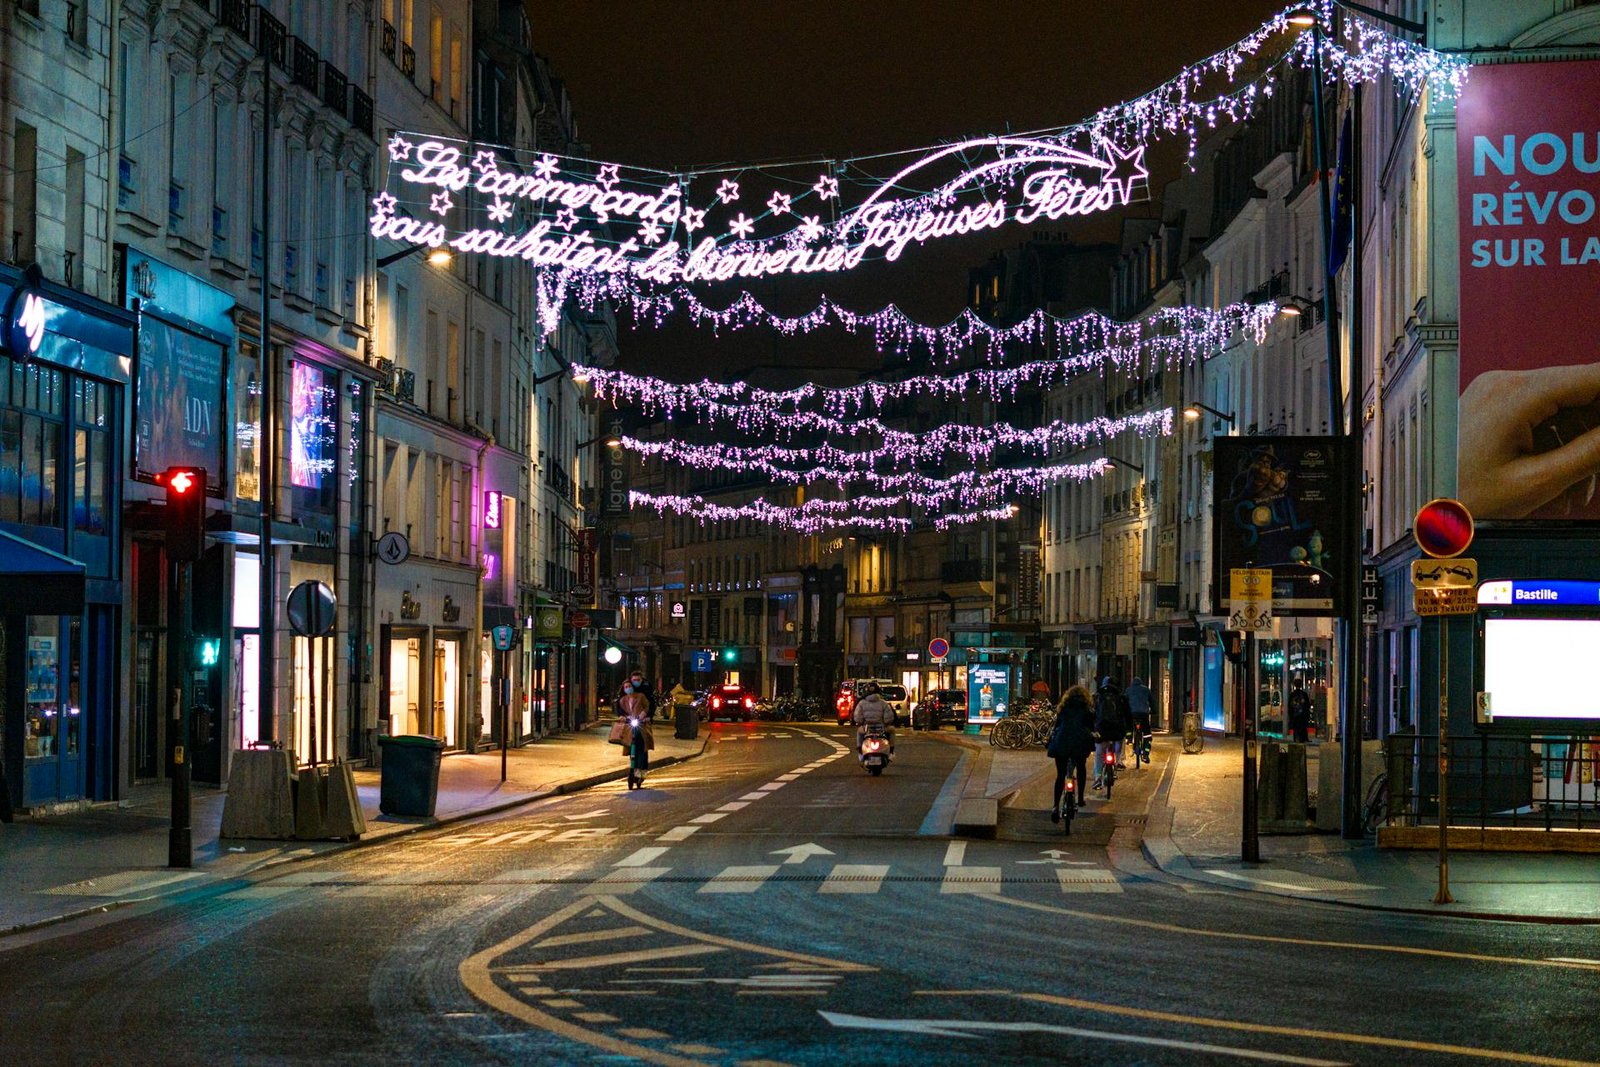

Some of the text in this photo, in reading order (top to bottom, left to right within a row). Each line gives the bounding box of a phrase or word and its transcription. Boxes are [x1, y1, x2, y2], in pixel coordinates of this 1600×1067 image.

[1473, 132, 1600, 176] NOU
[401, 139, 682, 224] Les commerçants
[848, 169, 1115, 268] Joyeuses Fêtes
[370, 212, 848, 282] vous souhaitent la bienvenue
[1471, 236, 1600, 268] SUR LA
[183, 395, 212, 436] ADN
[610, 418, 624, 465] roet
[1515, 589, 1558, 600] Bastille
